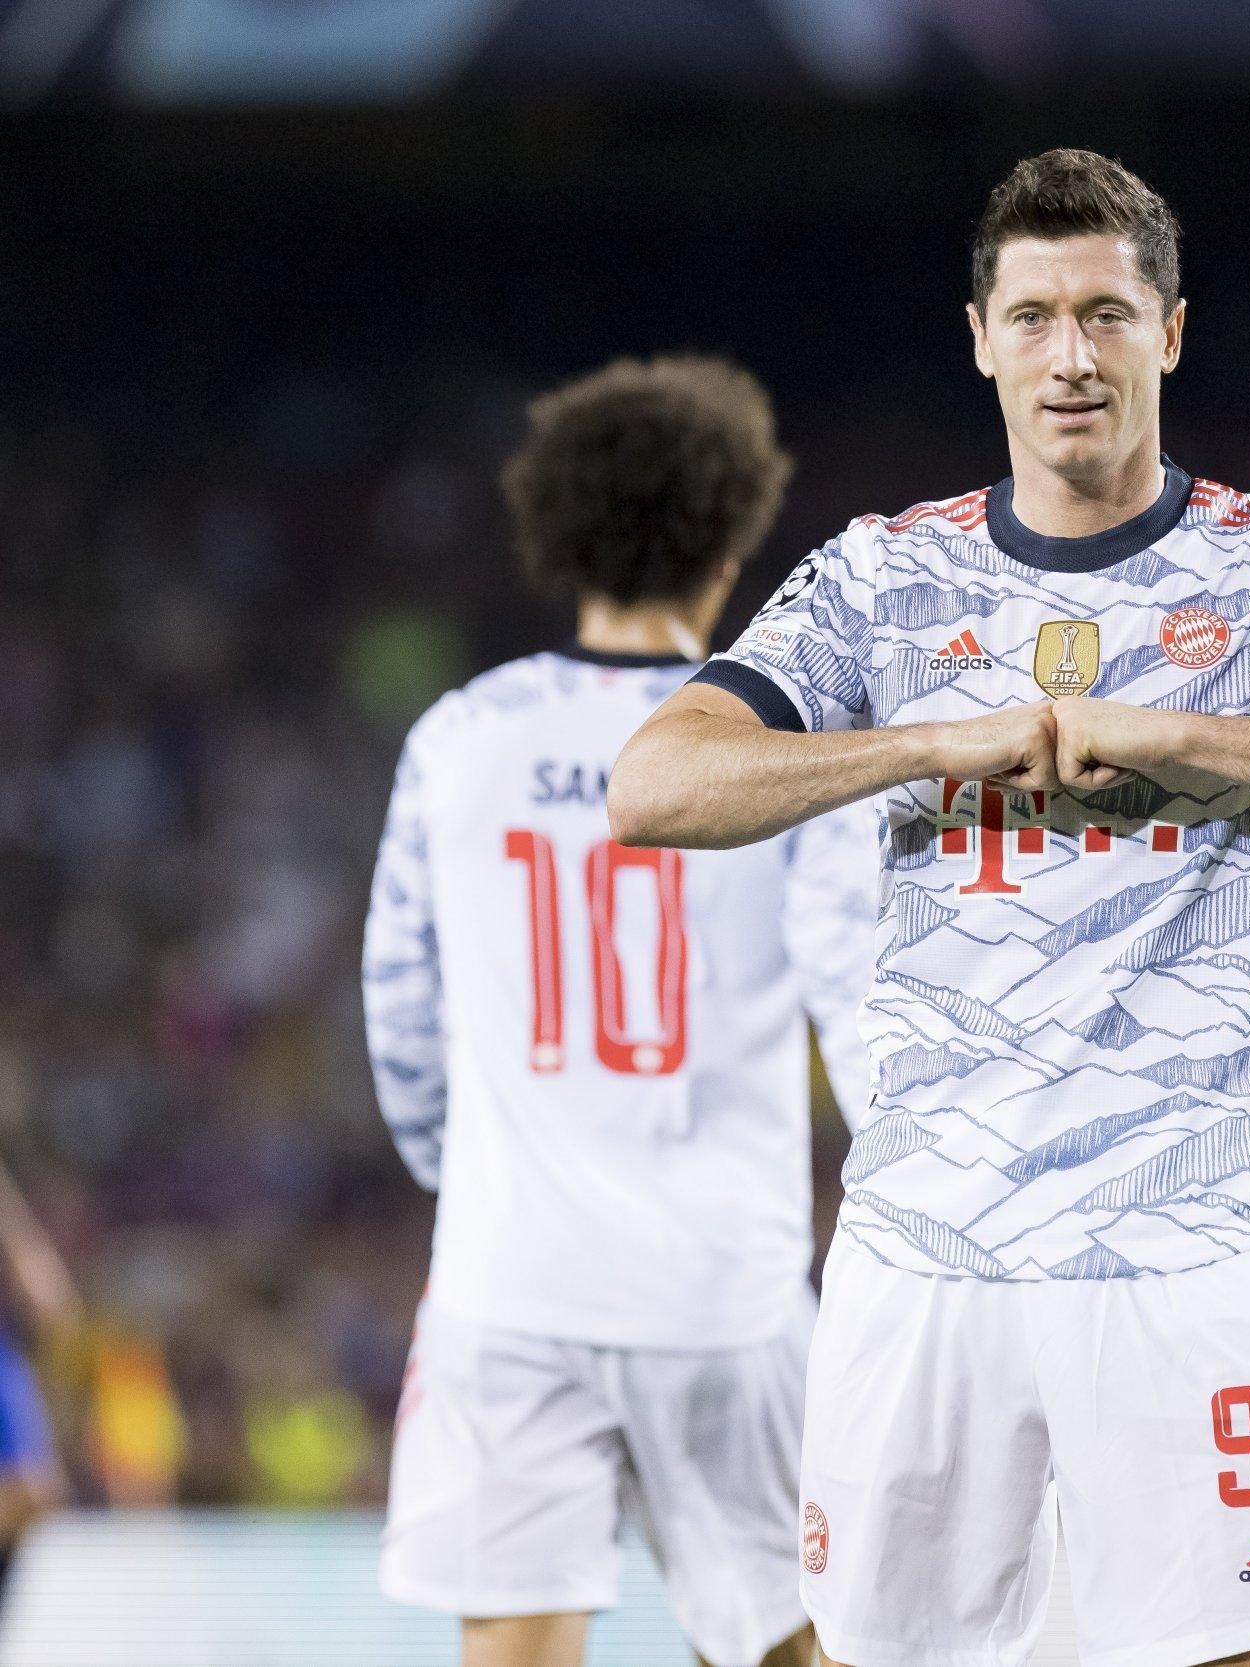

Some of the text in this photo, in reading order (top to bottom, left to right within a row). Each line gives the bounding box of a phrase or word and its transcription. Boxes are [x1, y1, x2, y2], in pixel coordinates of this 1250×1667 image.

[1164, 609, 1225, 631] FC BAYERN
[930, 654, 993, 671] adidas
[1050, 672, 1081, 684] FIFA
[506, 830, 687, 1075] 10
